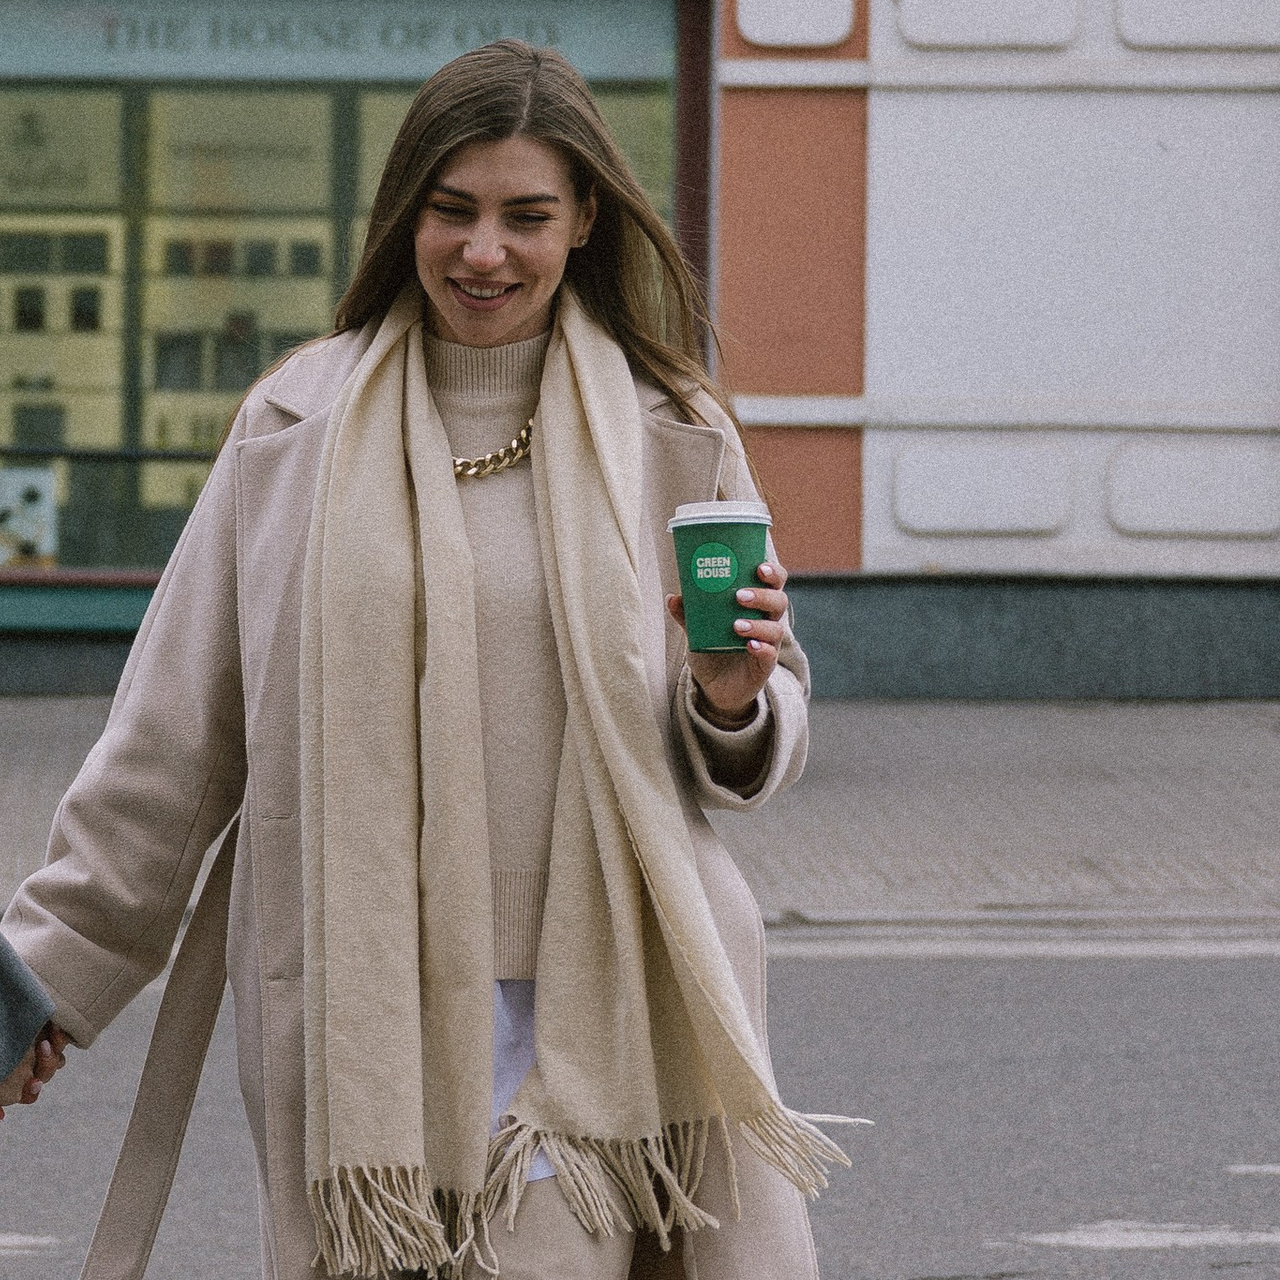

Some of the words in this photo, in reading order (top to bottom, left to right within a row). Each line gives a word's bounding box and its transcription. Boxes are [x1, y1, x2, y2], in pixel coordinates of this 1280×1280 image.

[101, 17, 190, 51] THE
[209, 17, 361, 52] HOUSE
[378, 17, 439, 51] OF
[696, 556, 731, 568] GREEN
[697, 567, 731, 579] HOUSE
